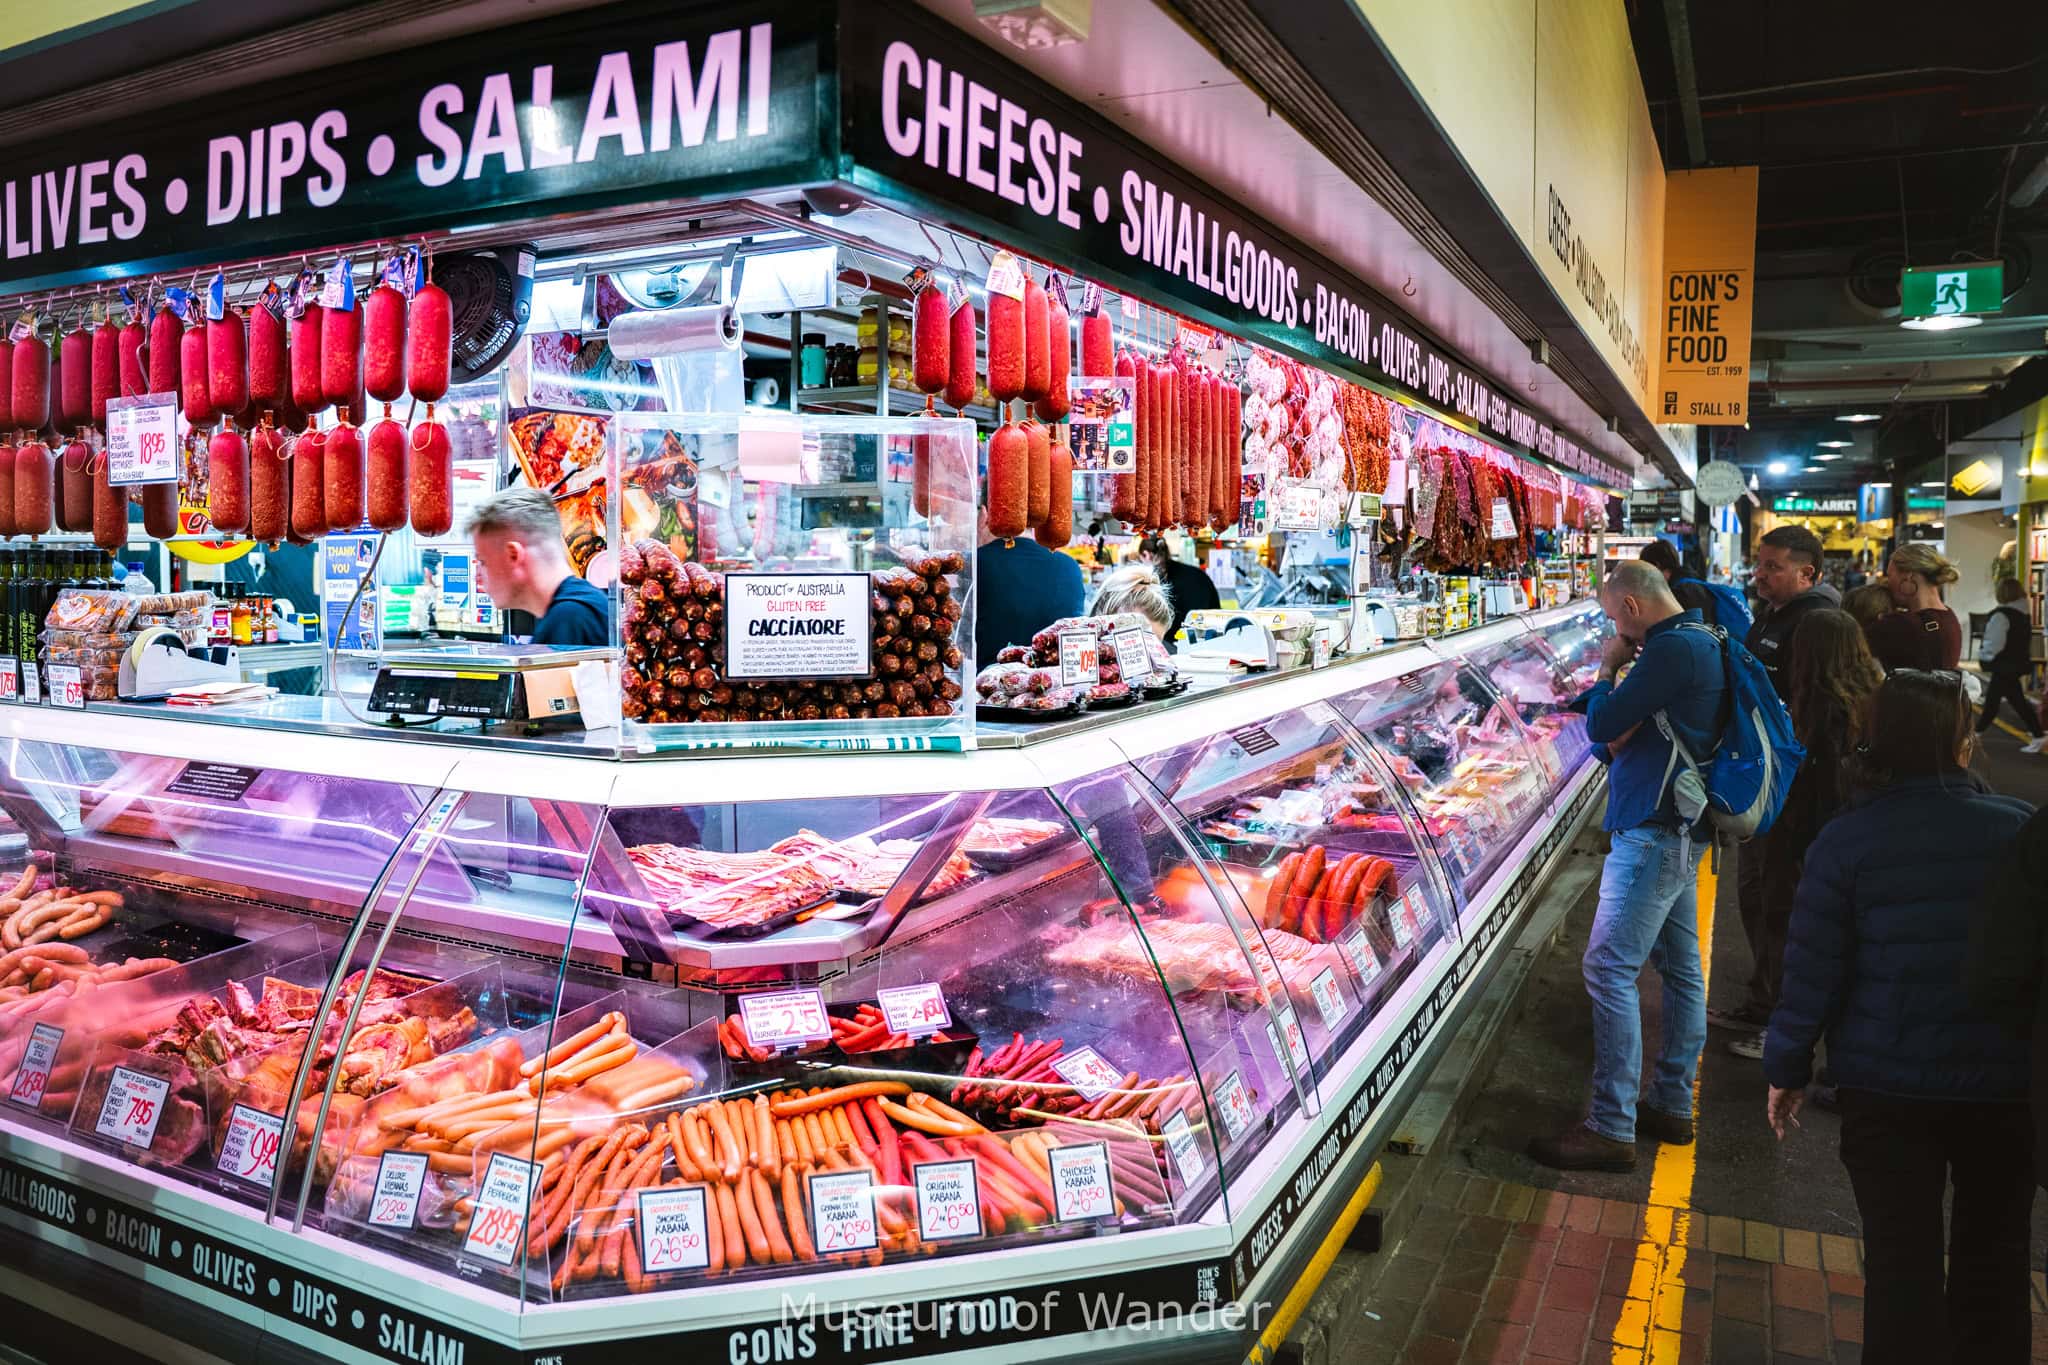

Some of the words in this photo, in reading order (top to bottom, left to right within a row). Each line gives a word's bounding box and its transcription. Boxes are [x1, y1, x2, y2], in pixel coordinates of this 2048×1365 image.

[0, 154, 148, 259] LIVES
[206, 109, 348, 226] DIPS
[416, 22, 772, 188] SALAMI
[882, 41, 1083, 230] CHEESE
[1120, 170, 1298, 330] SMALLGOODS
[1315, 283, 1370, 364] BACON
[1381, 323, 1420, 389] OLIVES
[1428, 354, 1449, 406] DIPS
[1456, 372, 1487, 424] SALAMI
[1549, 183, 1571, 273] CHEESE
[1669, 274, 1739, 301] CON'S
[1667, 305, 1720, 332] FINE
[1667, 336, 1727, 363] FOOD
[1706, 367, 1722, 376] EST.
[1725, 366, 1743, 376] 1959
[1690, 402, 1723, 416] STALL
[1728, 402, 1740, 416] 18
[327, 546, 356, 558] THANK
[332, 563, 350, 574] YOU
[746, 583, 787, 597] PRODUCT
[797, 580, 845, 596] AUSTRALIA
[767, 600, 802, 612] GLUTEN
[805, 600, 827, 612] FREE
[749, 616, 845, 636] CACCIATORE
[1250, 1209, 1284, 1268] CHEESE
[1295, 1128, 1341, 1209] SMALLGOODS
[1349, 1091, 1369, 1136] BACON
[1376, 1056, 1395, 1096] OLIVES
[1400, 1032, 1413, 1064] DIPS
[1417, 1001, 1435, 1040] SALAMI
[1060, 1164, 1096, 1177] CHICKEN
[926, 1180, 964, 1191] ORIGINAL
[1065, 1176, 1096, 1188] KABANA
[929, 1192, 961, 1202] KABANA
[656, 1213, 687, 1224] SMOKED
[827, 1210, 858, 1221] KABANA
[655, 1222, 690, 1235] KABANA
[1198, 1266, 1219, 1279] CON'S
[105, 1208, 161, 1260] BACON
[193, 1242, 256, 1297] OLIVES
[293, 1280, 337, 1328] DIPS
[378, 1312, 465, 1365] SALAMI
[1198, 1278, 1216, 1290] FINE
[1198, 1288, 1218, 1301] FOOD
[729, 1322, 817, 1365] CONS
[843, 1309, 914, 1353] FINE
[938, 1296, 1018, 1339] FOOD
